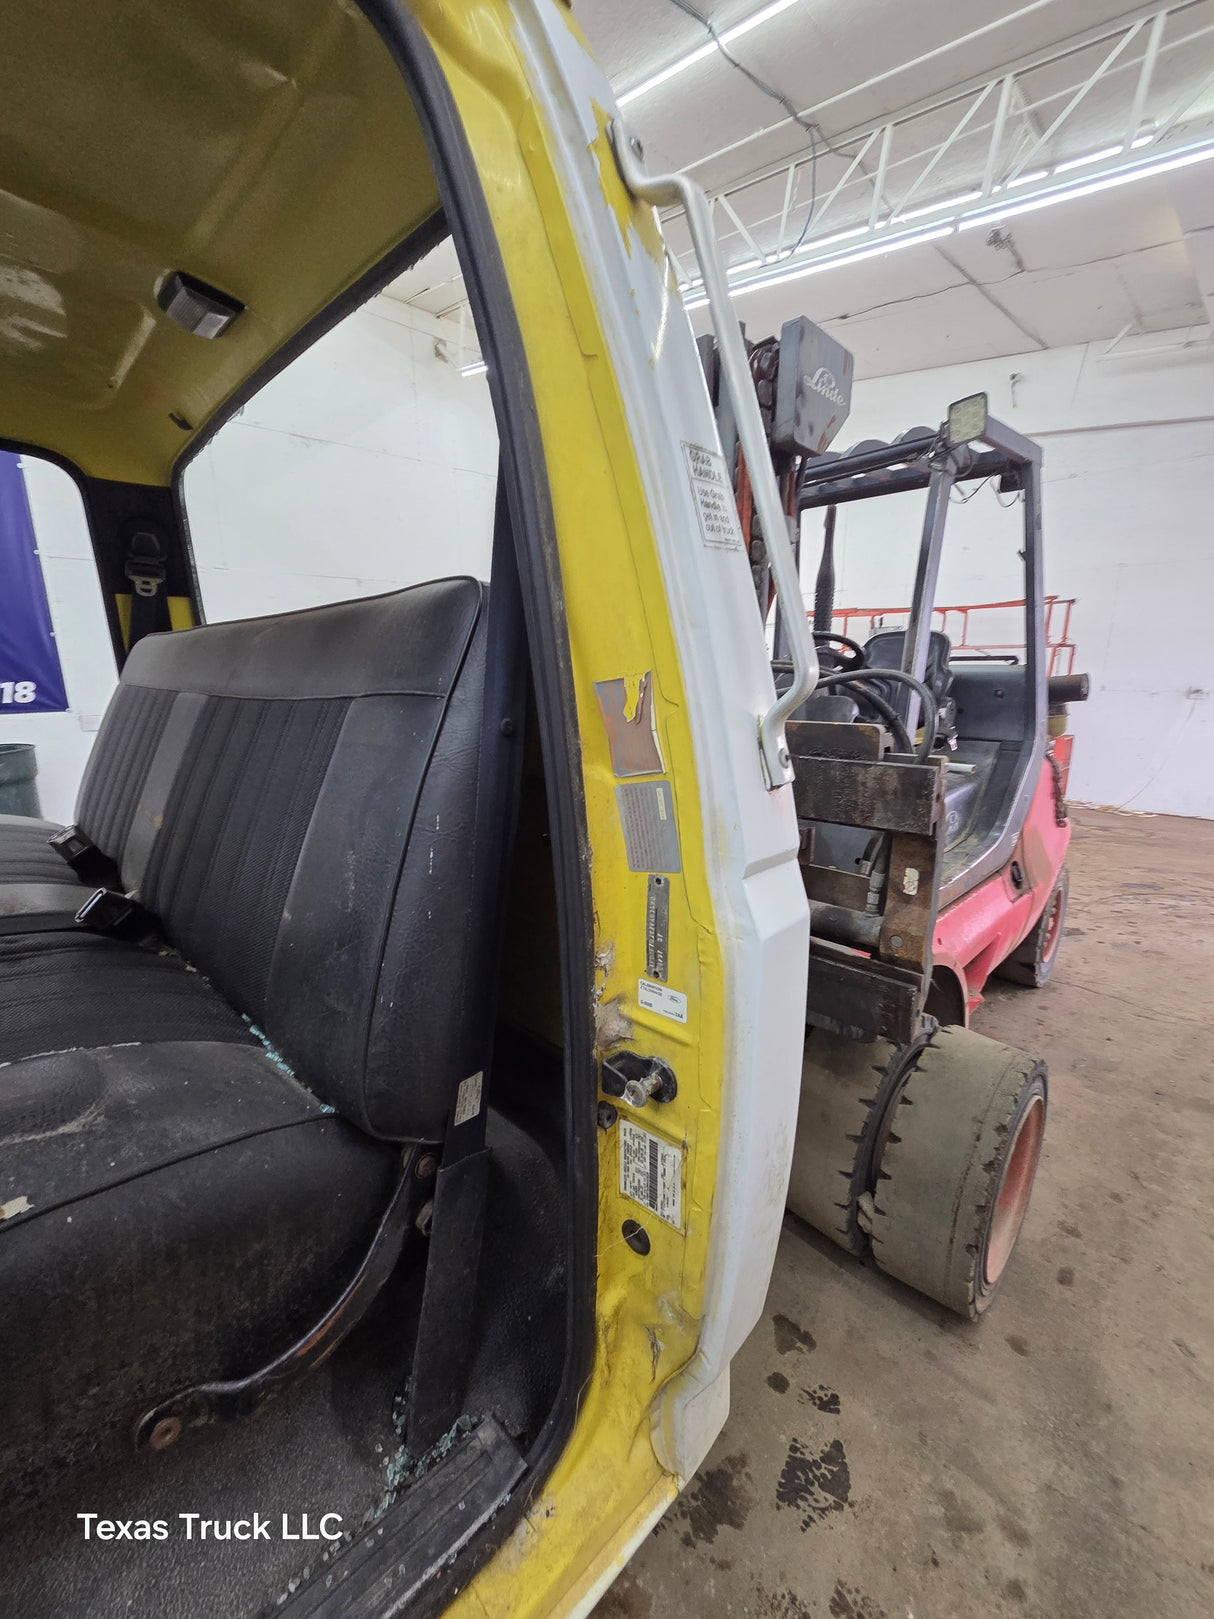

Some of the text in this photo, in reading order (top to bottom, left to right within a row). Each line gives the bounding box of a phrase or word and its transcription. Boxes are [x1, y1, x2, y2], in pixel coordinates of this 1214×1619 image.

[803, 367, 846, 406] Linde
[689, 449, 712, 467] GRAB
[693, 464, 723, 483] HANDLE
